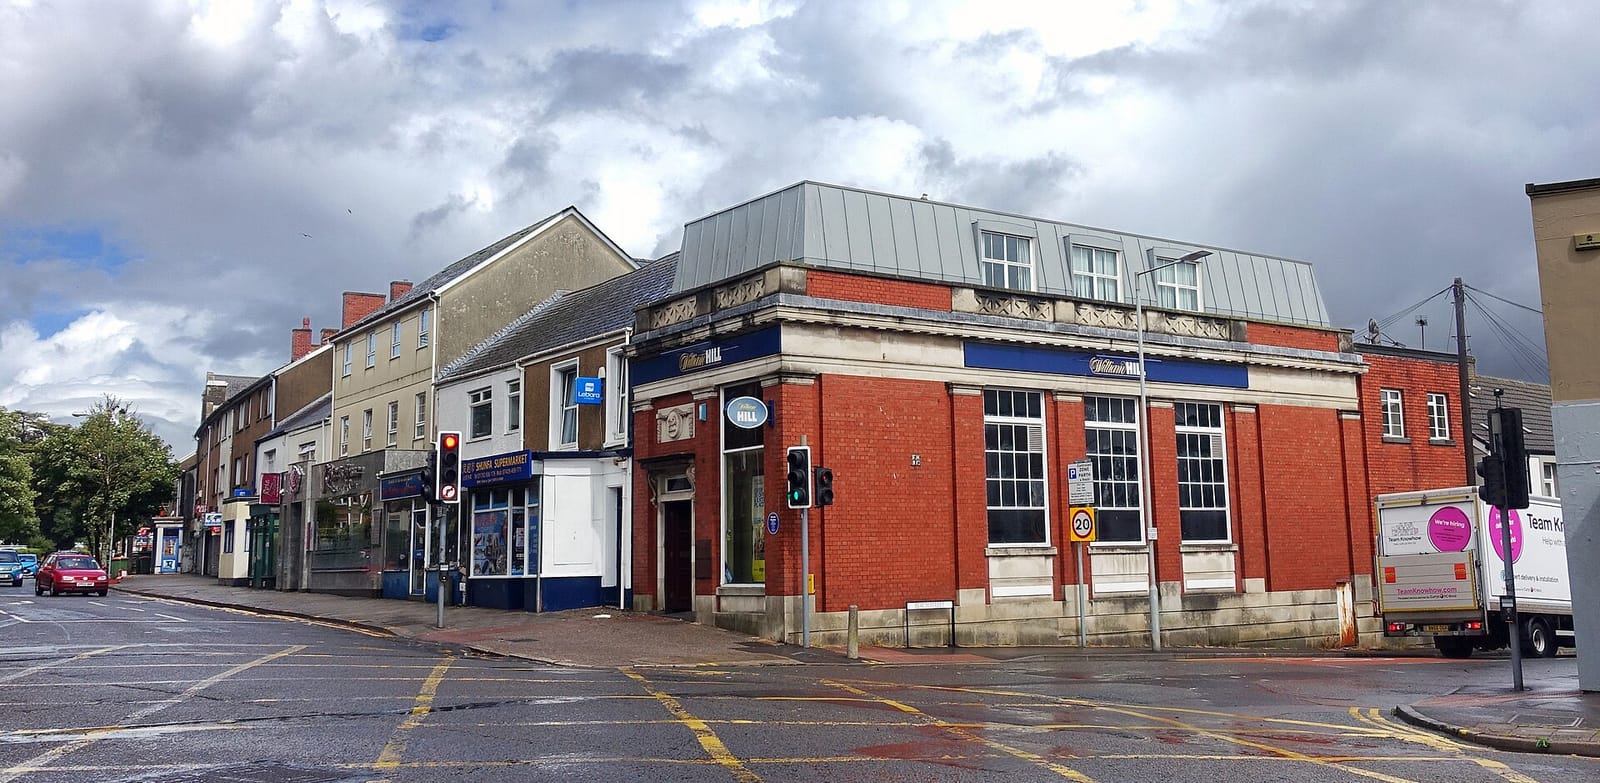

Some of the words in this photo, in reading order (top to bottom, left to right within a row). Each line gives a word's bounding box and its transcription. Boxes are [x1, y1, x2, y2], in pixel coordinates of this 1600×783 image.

[705, 346, 722, 364] HILL
[1089, 357, 1126, 375] William
[1126, 361, 1146, 376] HIL
[737, 411, 757, 422] HILL
[494, 454, 528, 469] SUPERMARKET
[1075, 518, 1090, 531] 20
[1449, 520, 1465, 529] hiring
[1527, 513, 1553, 531] Team
[1397, 587, 1457, 596] TeamKnowhow.com
